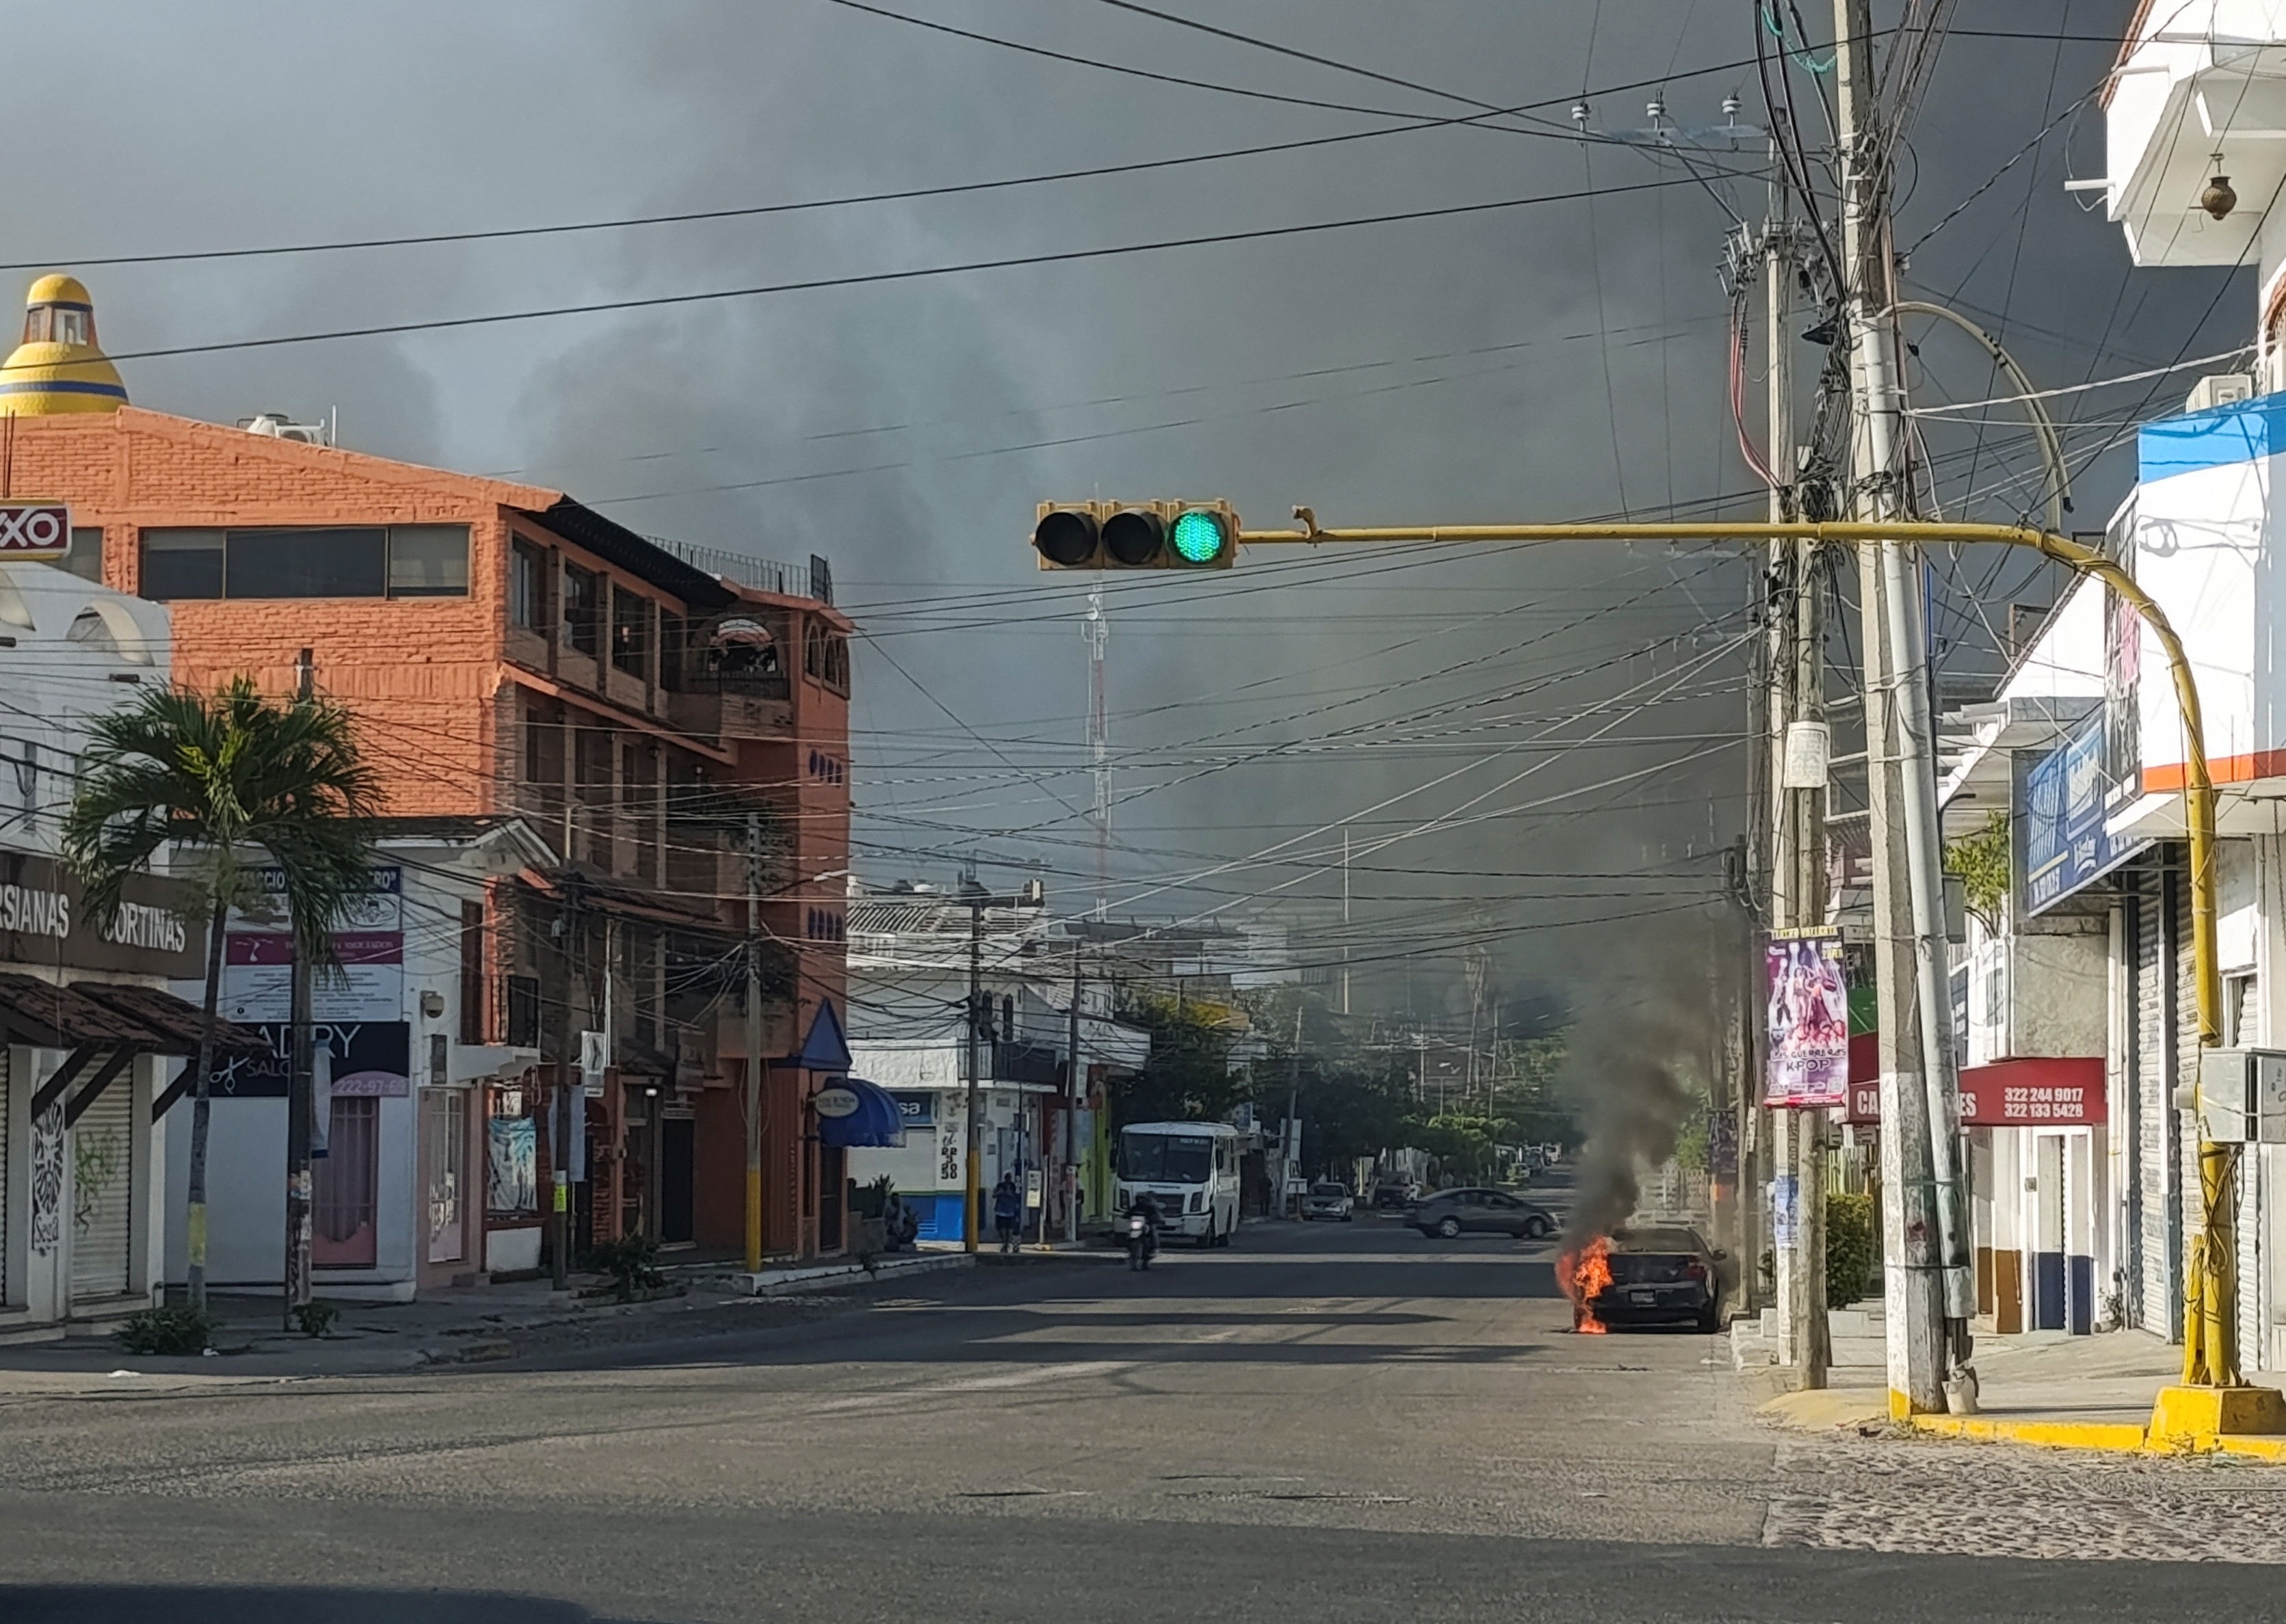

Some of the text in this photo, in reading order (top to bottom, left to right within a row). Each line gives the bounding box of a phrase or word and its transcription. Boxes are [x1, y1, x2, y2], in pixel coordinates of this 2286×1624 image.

[0, 507, 59, 548] XO
[2005, 1087, 2084, 1102] 322 244 9017
[2005, 1102, 2084, 1117] 322 133 5428
